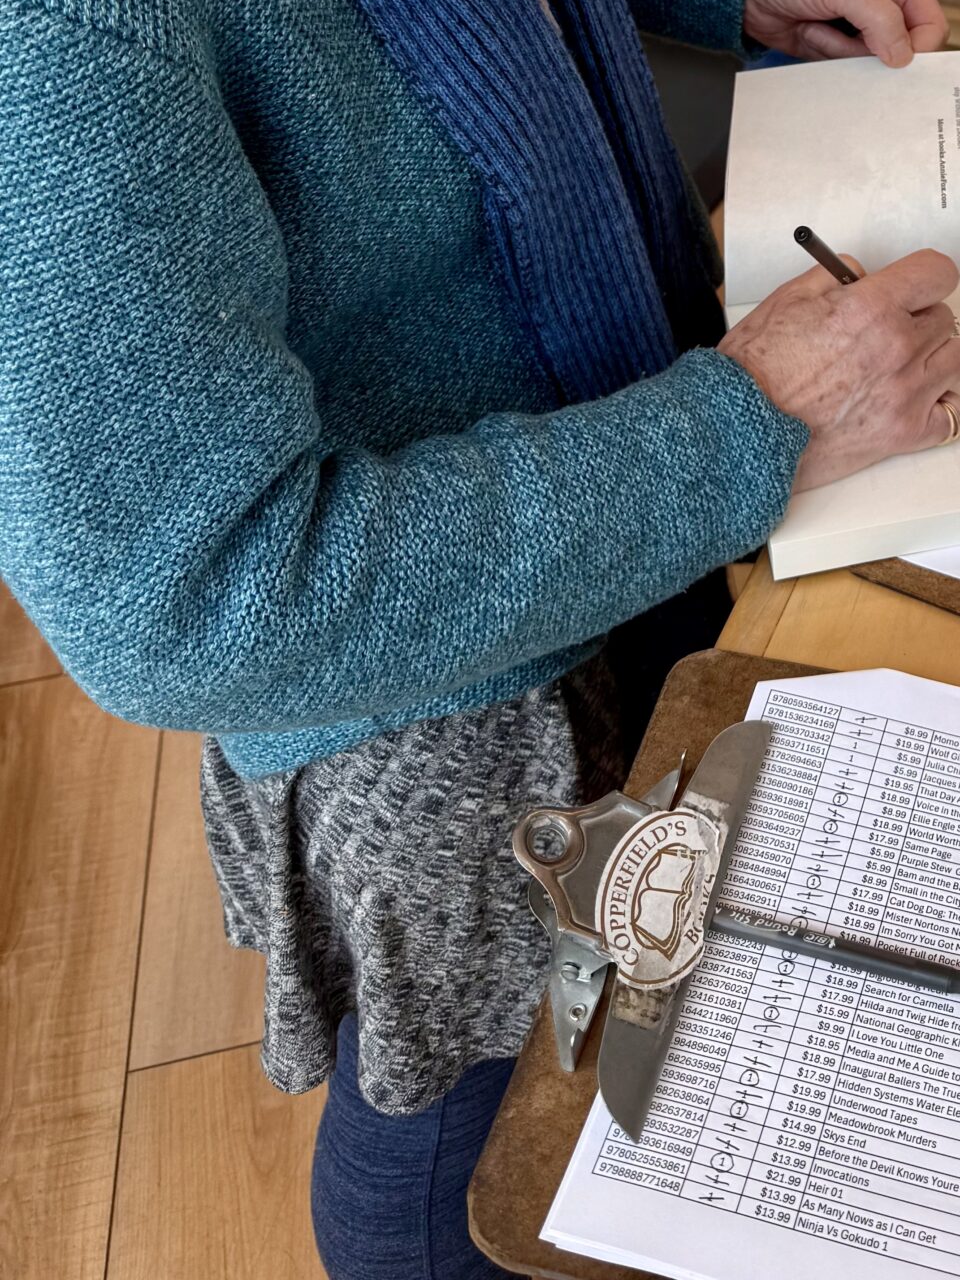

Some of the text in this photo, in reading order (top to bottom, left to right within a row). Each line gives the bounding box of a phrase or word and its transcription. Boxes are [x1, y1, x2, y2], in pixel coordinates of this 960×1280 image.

[767, 707, 835, 729] 9781536234169
[896, 738, 925, 752] $19.99
[930, 747, 949, 759] Wolf
[772, 694, 840, 717] 9780593564127
[904, 726, 928, 740] $8.99
[934, 735, 960, 749] Momo
[927, 760, 945, 772] Julia
[923, 773, 956, 789] Jacques
[916, 800, 938, 813] Voice
[909, 827, 934, 841] World
[935, 833, 960, 848] Worth
[901, 855, 929, 871] Purple
[930, 861, 952, 874] Stew
[730, 912, 830, 947] BIC Round Stic
[912, 995, 955, 1014] Carmella
[856, 1014, 895, 1032] National
[897, 1025, 950, 1045] Geographic
[833, 1095, 888, 1118] Underwood
[890, 1109, 918, 1126] Tapes
[828, 1112, 938, 1149] Meadowbrook Murders
[813, 1163, 870, 1187] Invocations
[600, 1163, 880, 1250] 9798888771648 $13.99 Ninja Gokudo
